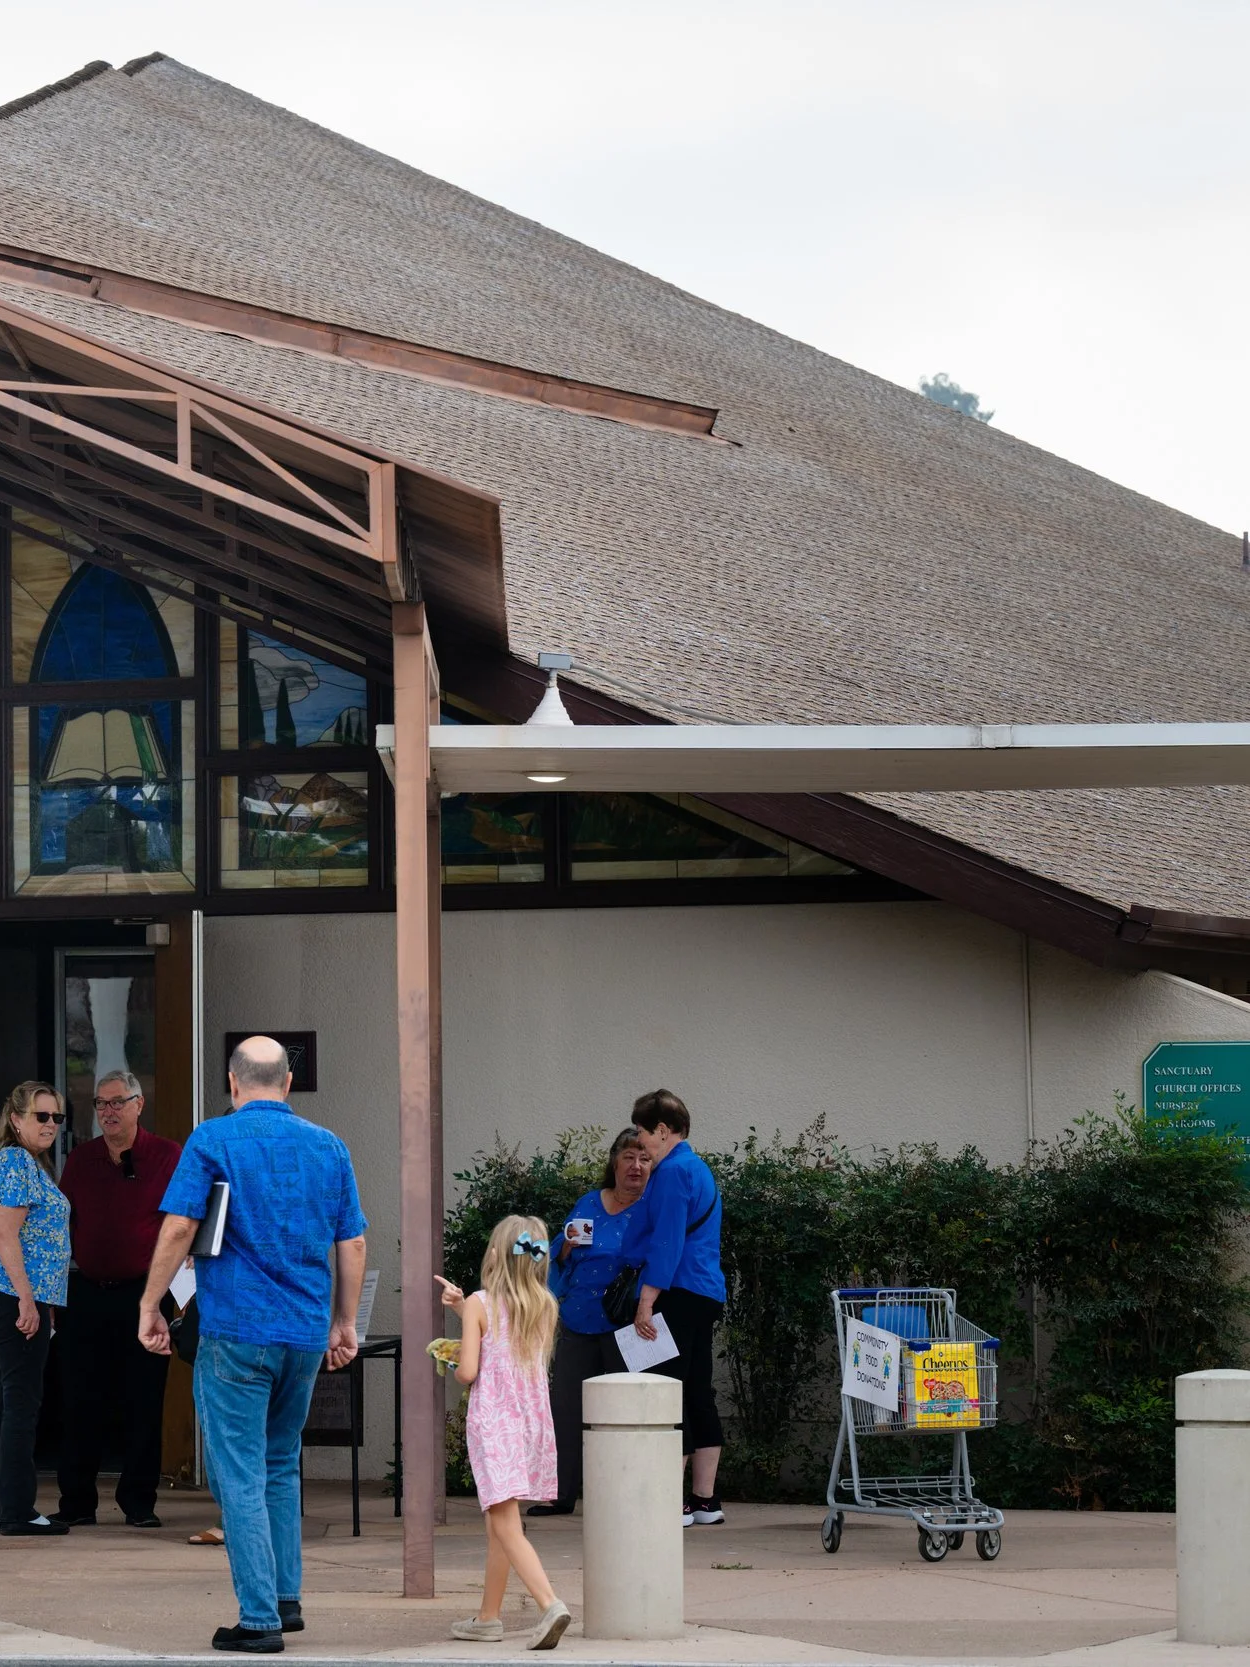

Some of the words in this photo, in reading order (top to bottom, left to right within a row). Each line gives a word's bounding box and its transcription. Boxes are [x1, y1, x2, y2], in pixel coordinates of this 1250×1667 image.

[1154, 1066, 1214, 1076] SANCTUARY
[1154, 1083, 1197, 1093] CHURCH
[1200, 1083, 1242, 1093] OFFICES
[856, 1331, 889, 1352] COMMUNITY
[865, 1354, 879, 1368] FOOD
[922, 1357, 969, 1372] Cheerios
[856, 1370, 887, 1391] DONATIONS
